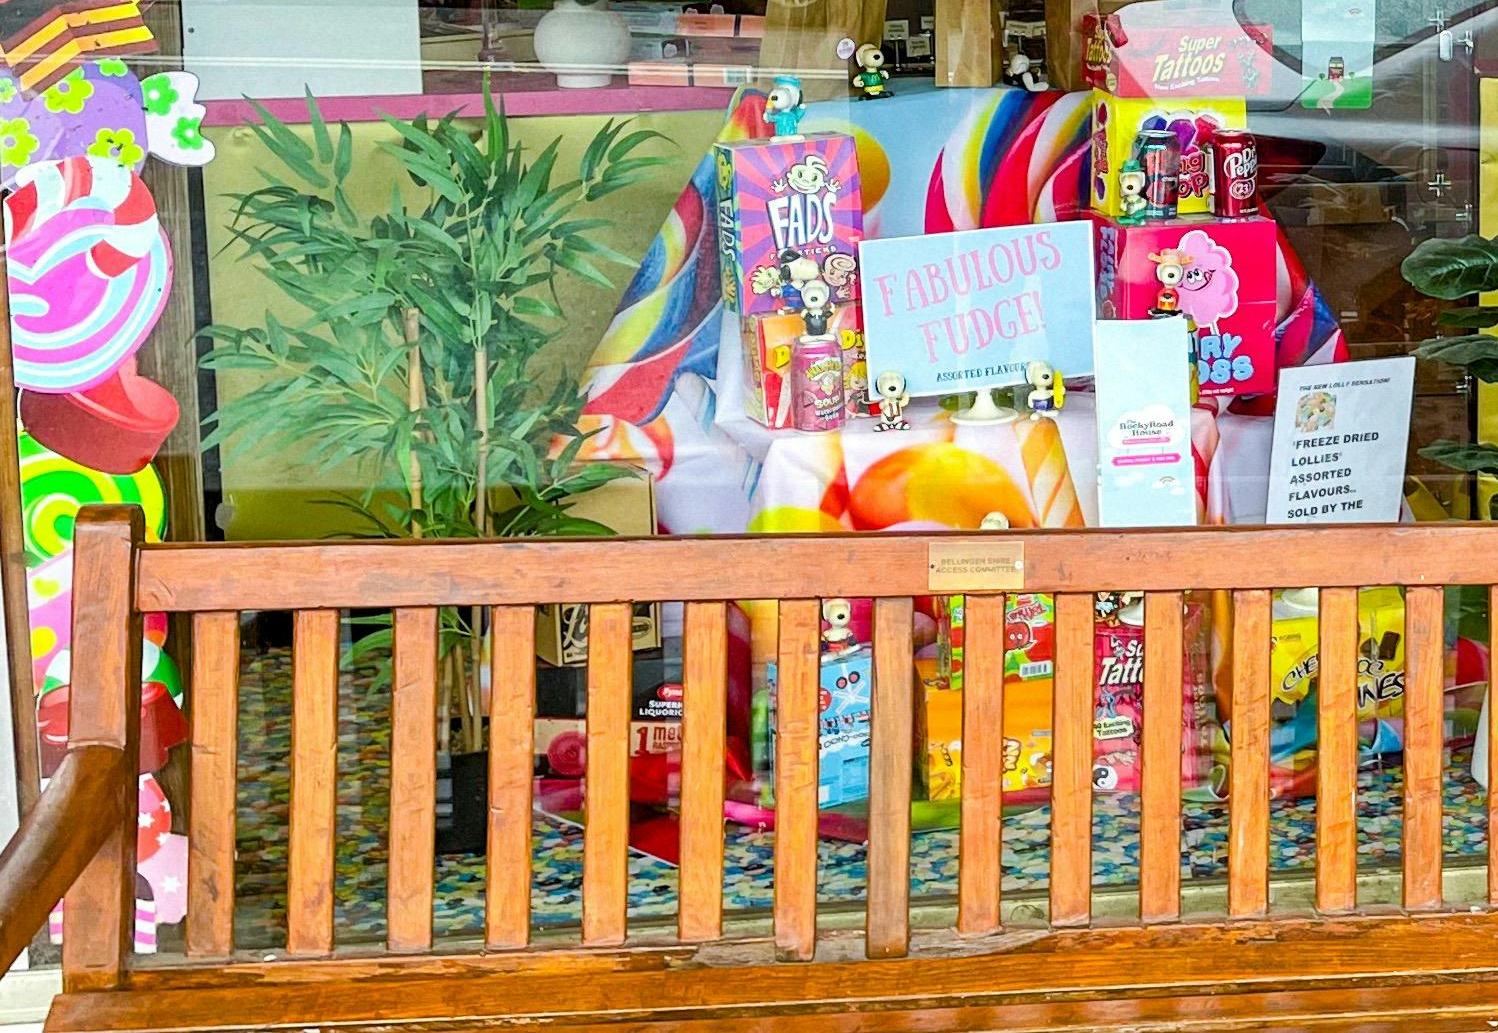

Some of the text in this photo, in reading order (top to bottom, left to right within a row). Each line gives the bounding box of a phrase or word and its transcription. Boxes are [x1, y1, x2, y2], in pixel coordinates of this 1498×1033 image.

[1177, 34, 1223, 55] Super
[1152, 51, 1227, 84] Tattoos
[1236, 183, 1250, 194] 23
[718, 197, 736, 262] FADS
[766, 192, 837, 250] FADS
[873, 231, 1062, 317] FABULOUS
[918, 290, 1048, 364] FUDGE!
[936, 369, 982, 382] ASSORTED
[1199, 355, 1255, 385] OSS
[1343, 431, 1379, 444] DRIED
[1289, 467, 1352, 485] ASSORTED
[1287, 499, 1364, 519] SOLD BY THE
[935, 565, 1016, 574] ACCESS COMMITTEE
[940, 557, 986, 566] BELLINGEN
[1099, 657, 1144, 686] Tatt
[639, 708, 683, 717] LIQUORIC
[634, 727, 649, 755] 1
